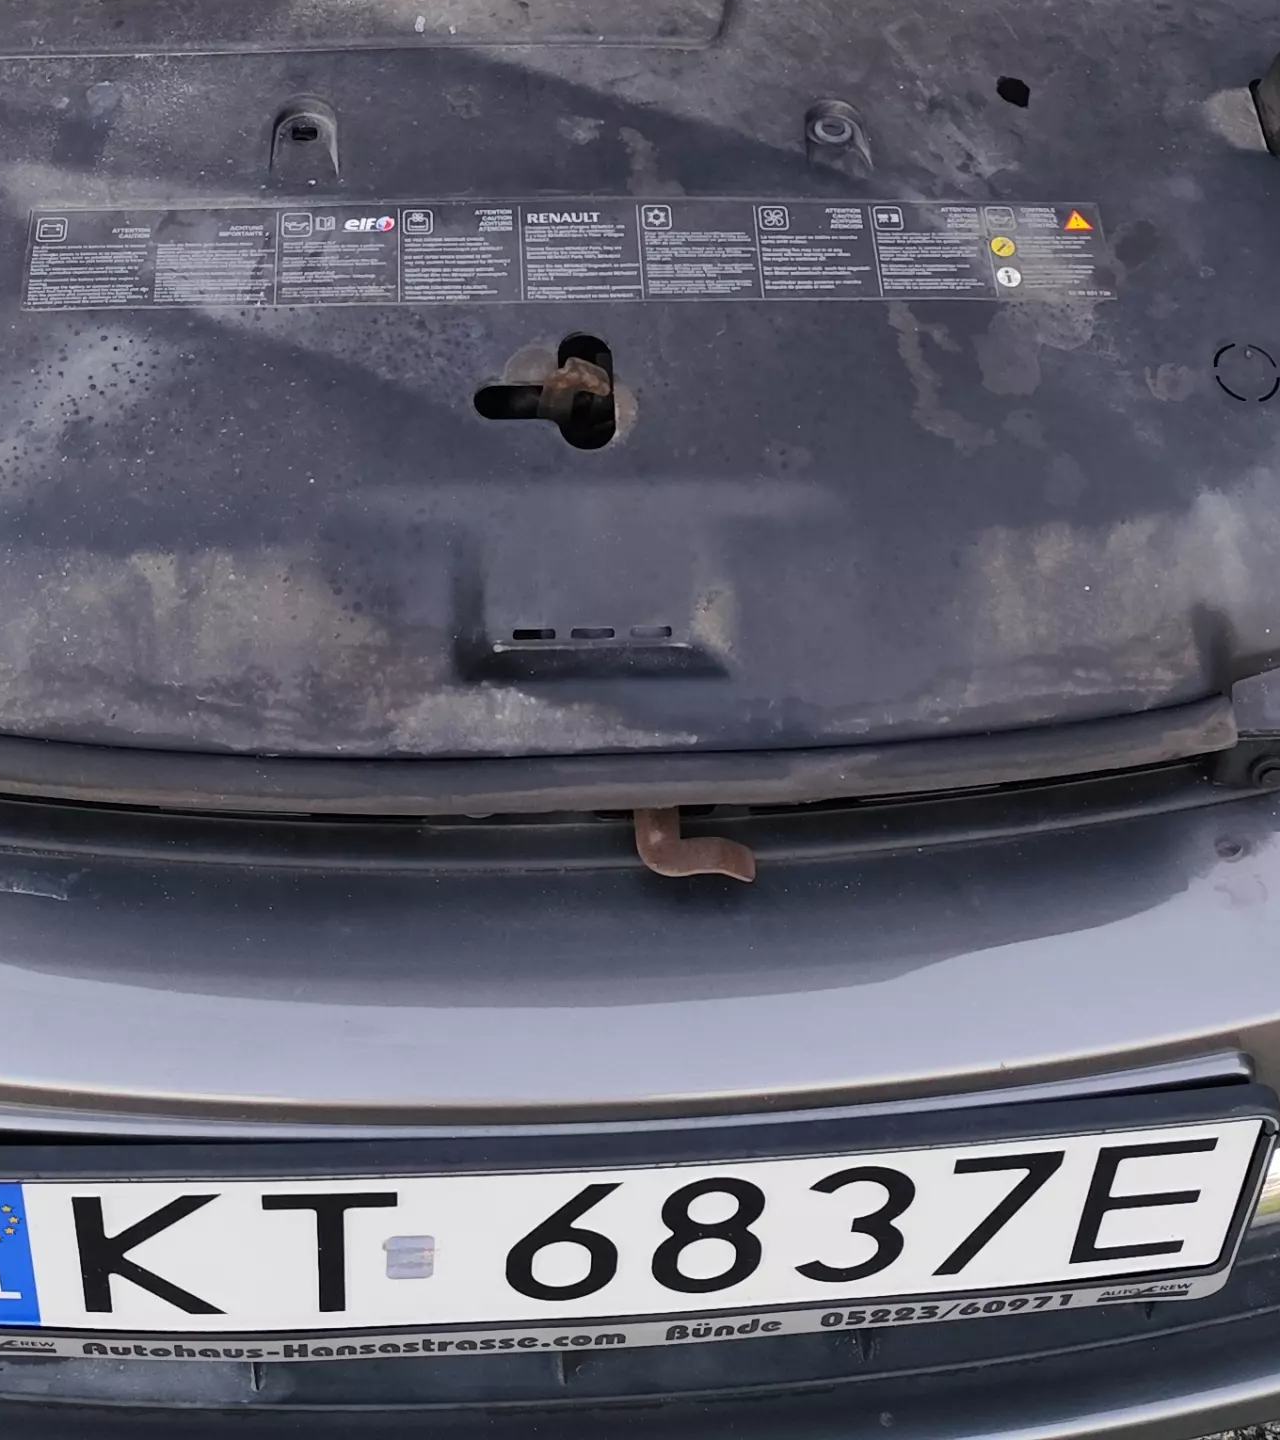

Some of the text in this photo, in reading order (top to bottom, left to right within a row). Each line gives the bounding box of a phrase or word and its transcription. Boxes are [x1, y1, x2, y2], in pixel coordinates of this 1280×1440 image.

[526, 212, 601, 223] RENAULT
[71, 1137, 1218, 1315] KT 6837E
[82, 1293, 1073, 1360] Autohaus-Hansastrasse.com Bünde 05223/60971
